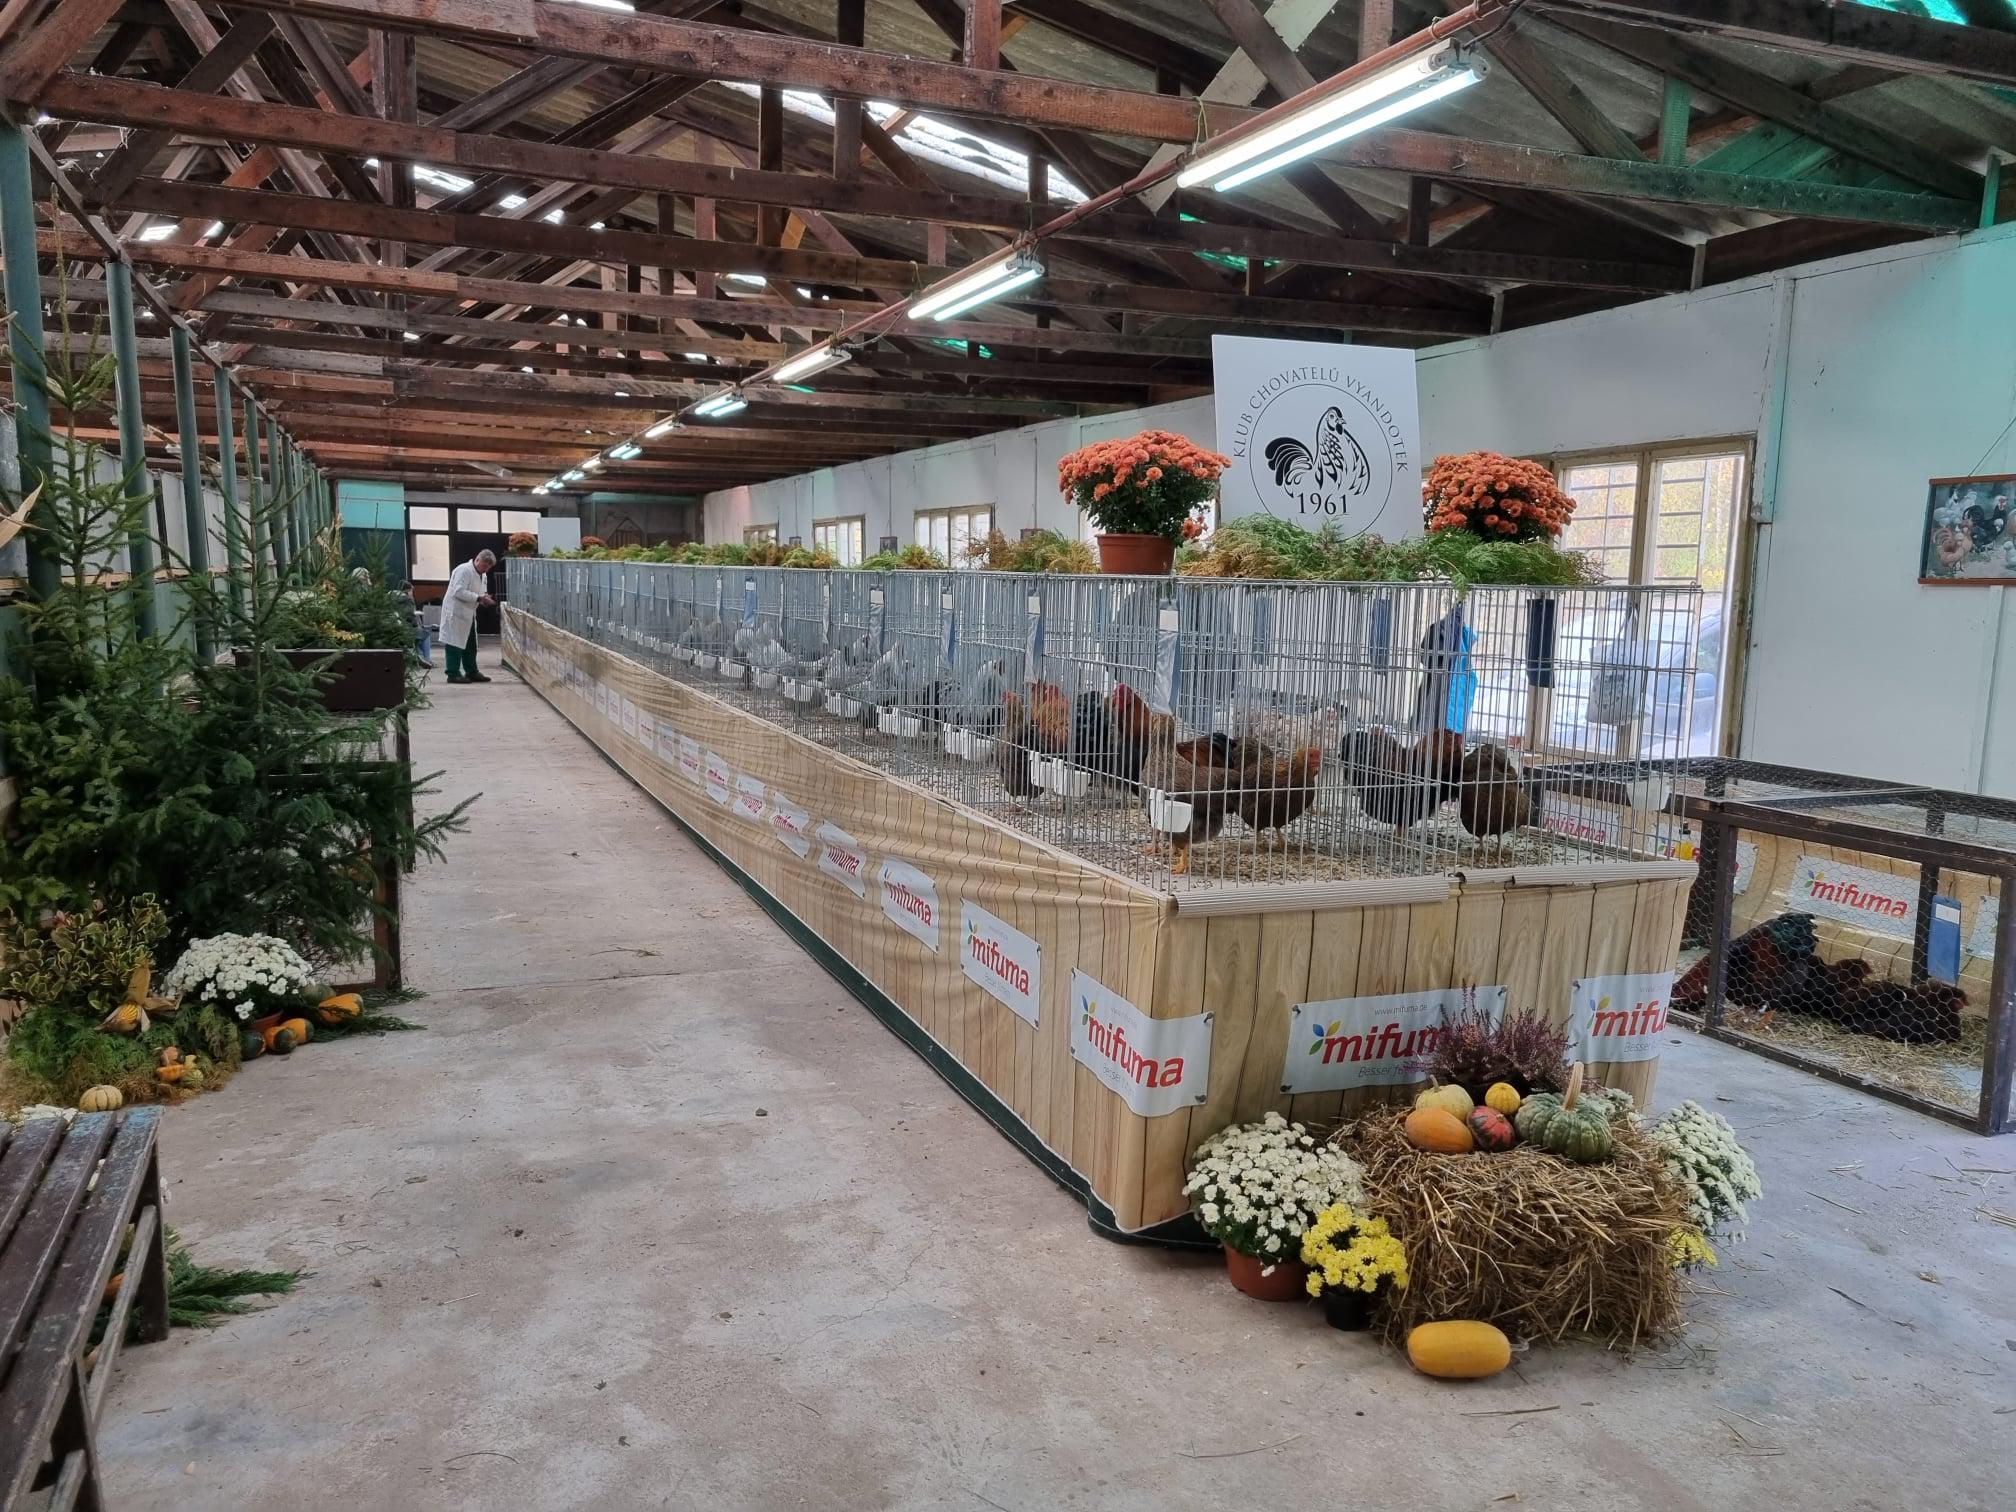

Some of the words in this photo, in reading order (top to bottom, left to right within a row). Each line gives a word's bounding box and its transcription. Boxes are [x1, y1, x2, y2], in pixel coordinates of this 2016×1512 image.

[1233, 412, 1253, 458] KLUB
[1249, 367, 1339, 409] CHOVATELŮ
[1346, 375, 1409, 472] VYANDOTEK
[1298, 492, 1350, 515] 1961
[885, 881, 932, 927] mifuma
[1810, 880, 1909, 919] mifuma
[972, 935, 1029, 996] mifuma
[1592, 1000, 1667, 1036] mifu
[1088, 1015, 1184, 1088] mifuma
[1322, 1023, 1438, 1064] mifum
